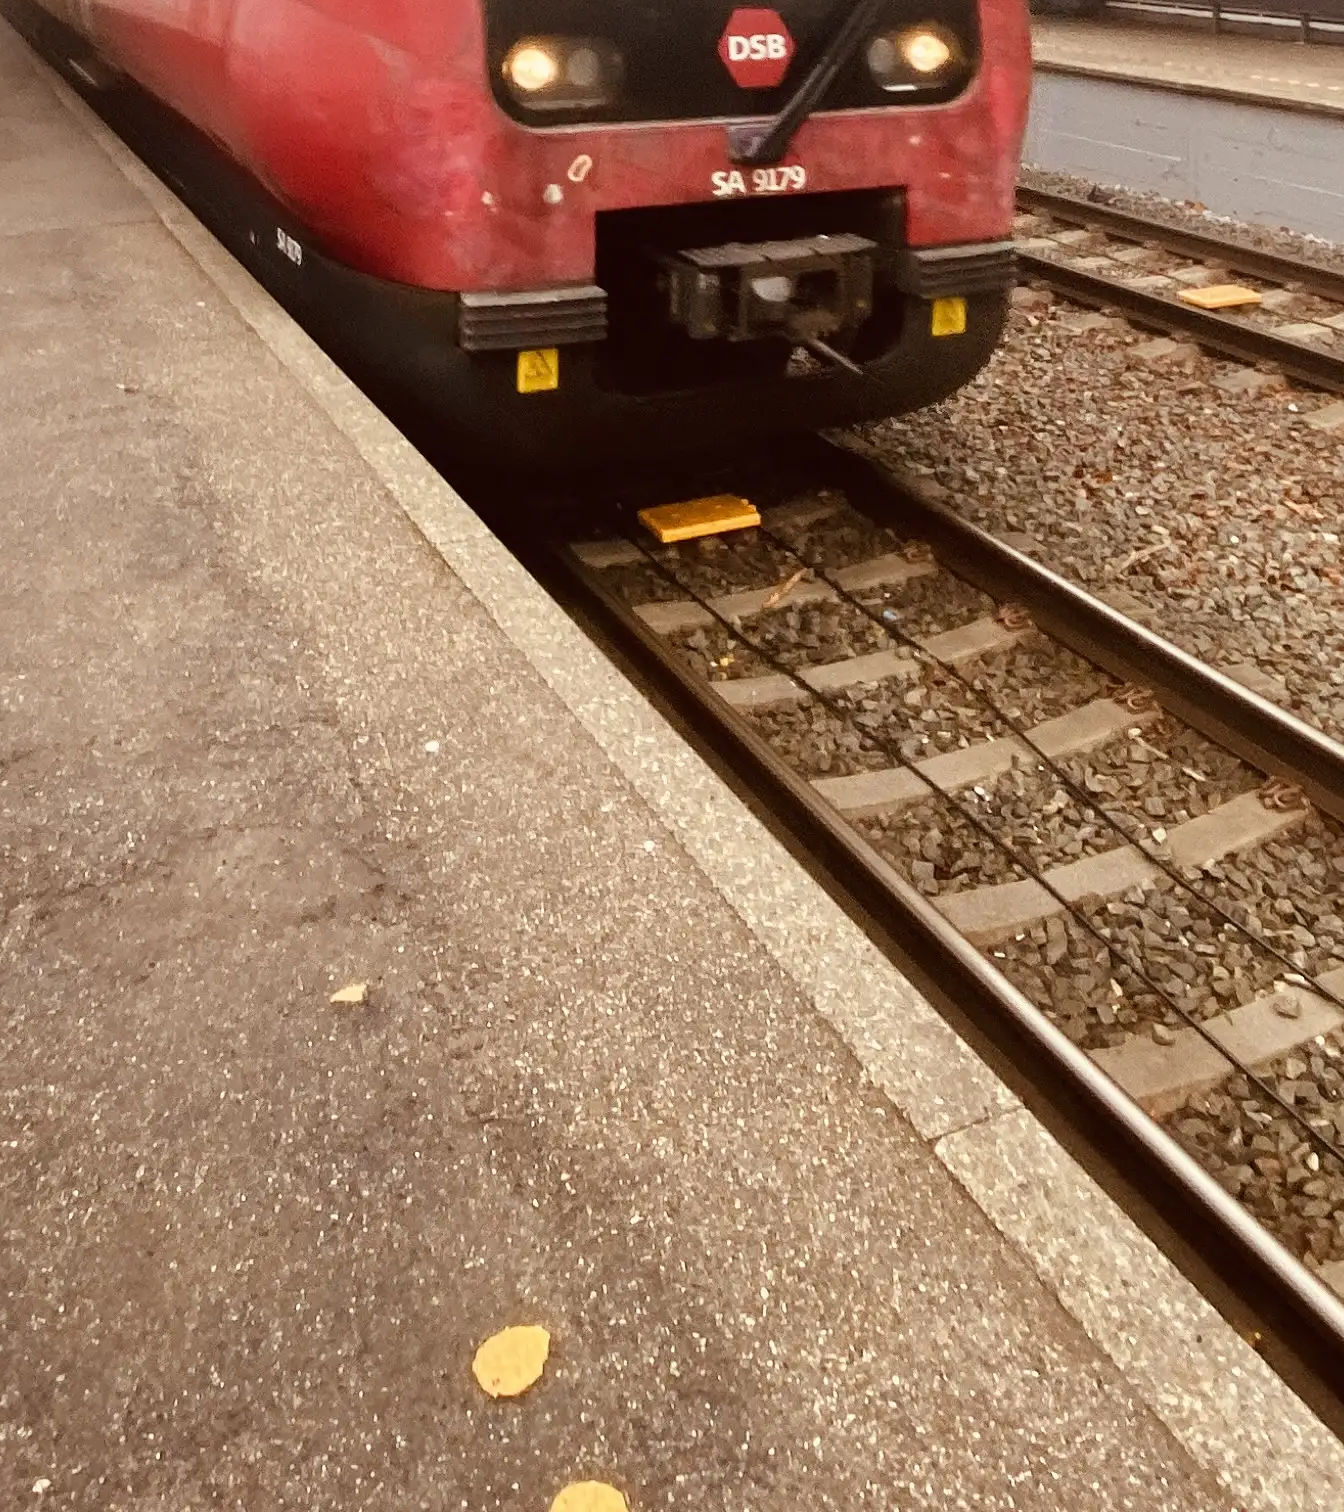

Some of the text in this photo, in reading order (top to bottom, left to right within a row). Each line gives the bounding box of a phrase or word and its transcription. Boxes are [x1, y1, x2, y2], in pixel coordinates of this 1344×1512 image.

[727, 34, 787, 61] DSB
[711, 165, 806, 197] SA 9179
